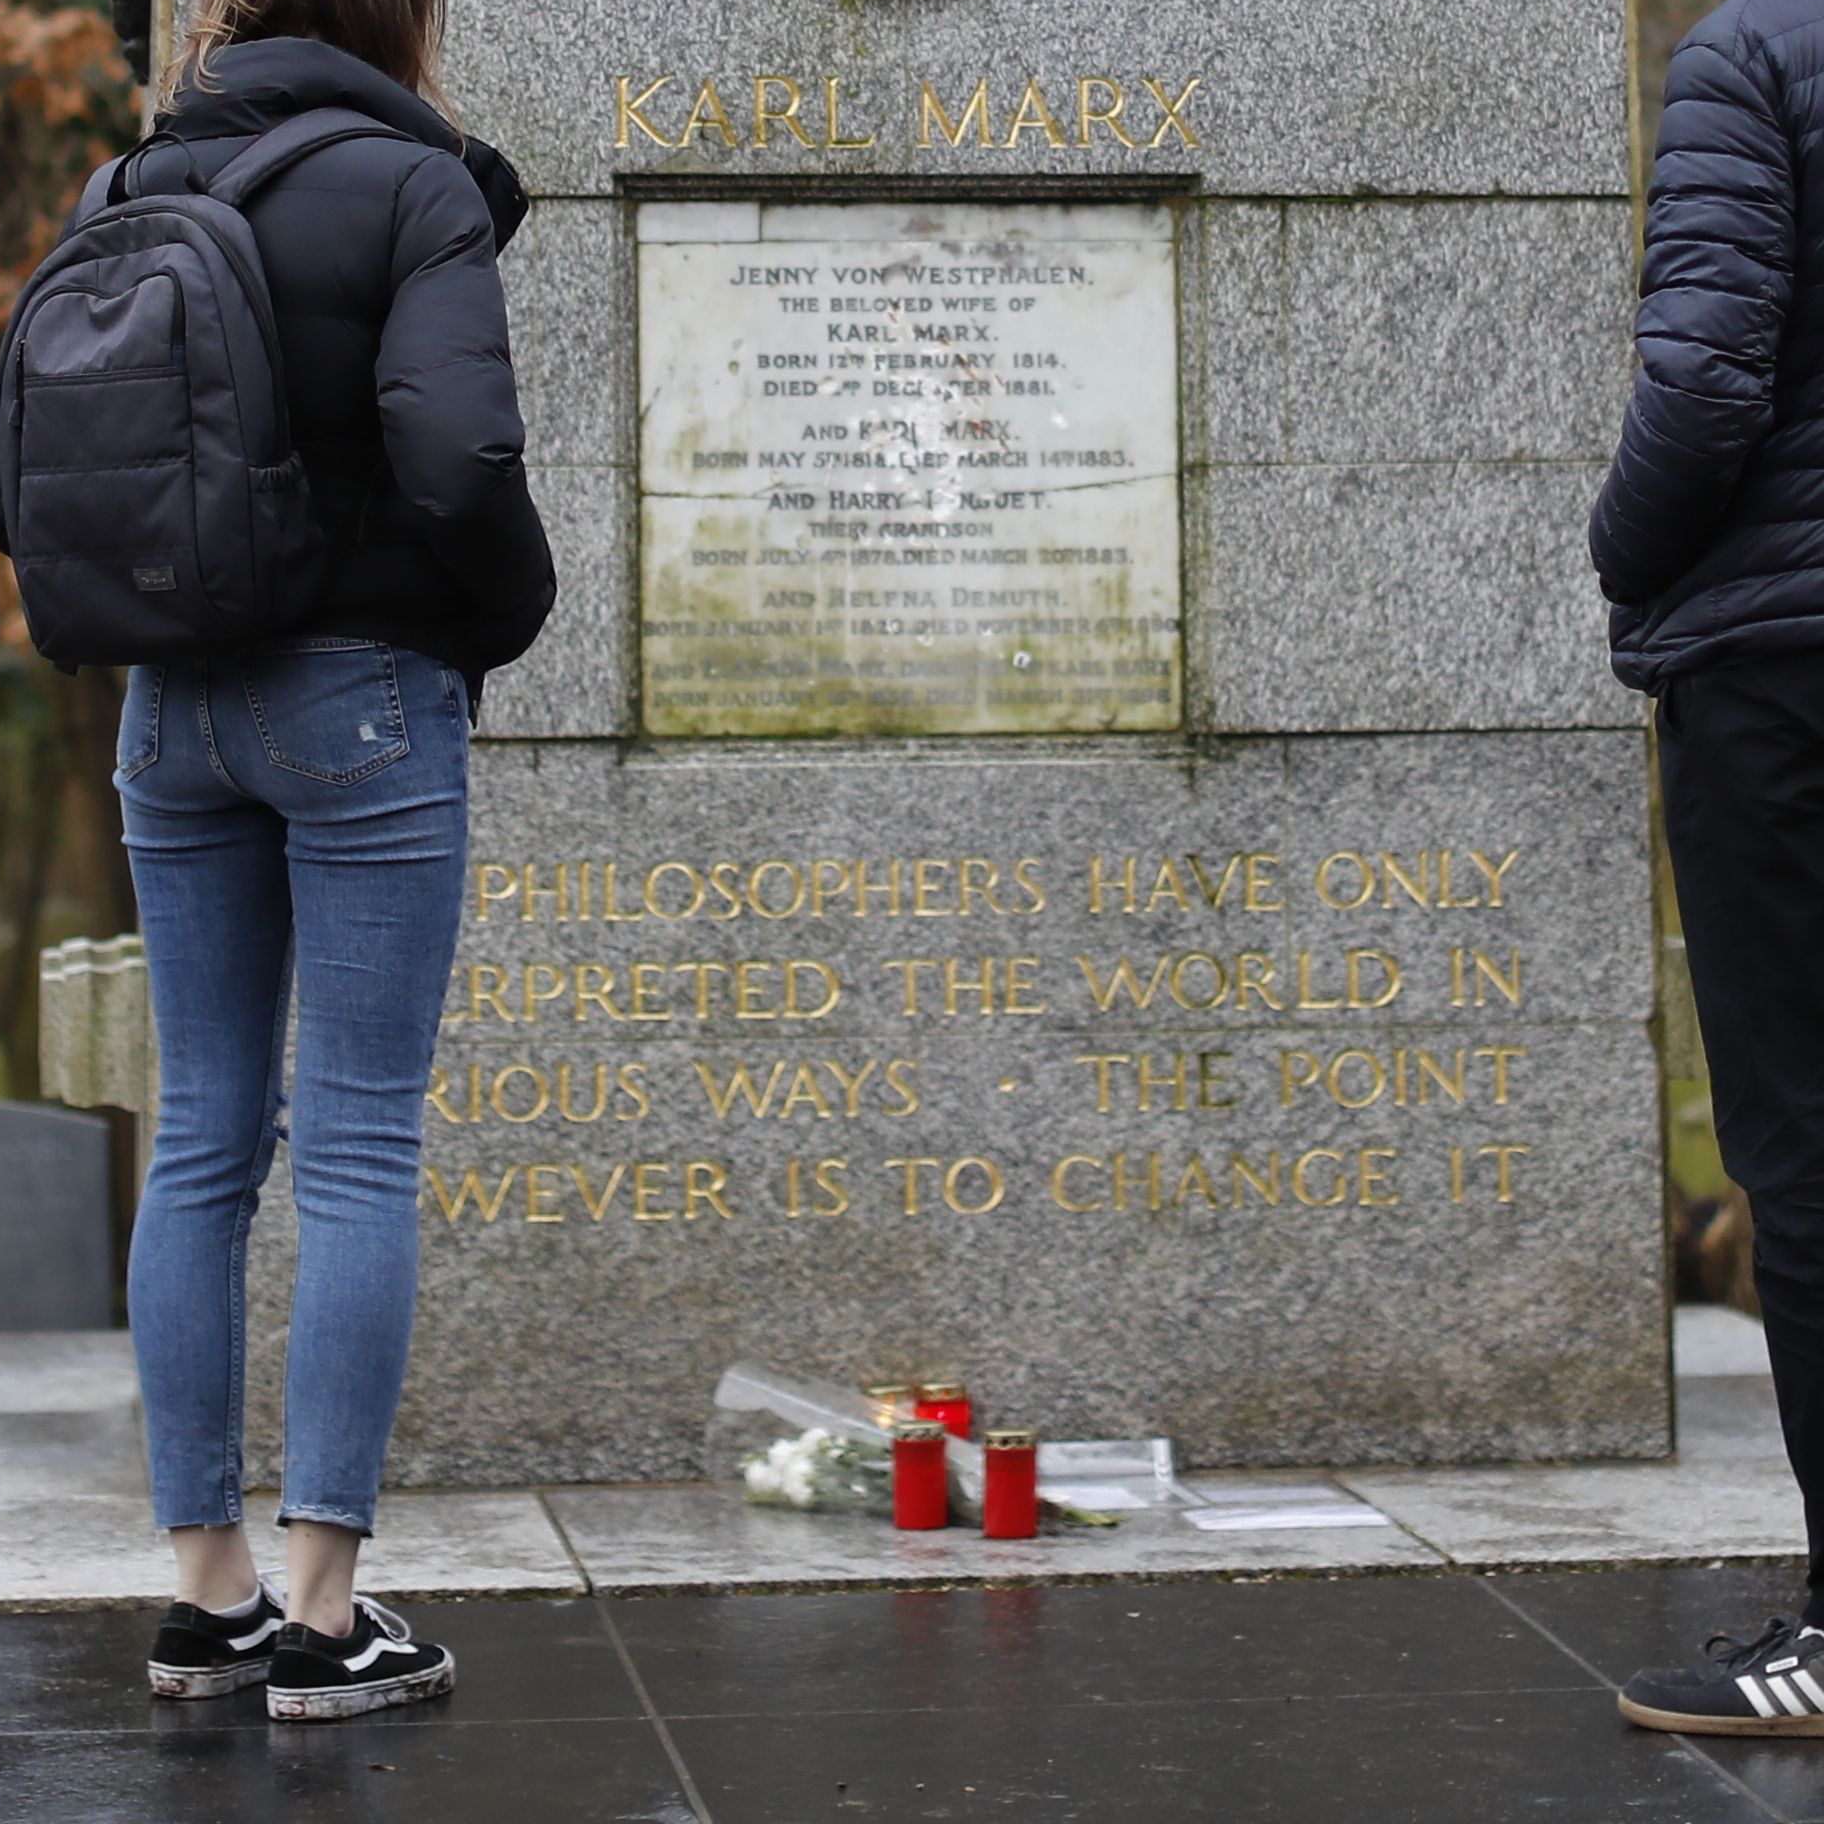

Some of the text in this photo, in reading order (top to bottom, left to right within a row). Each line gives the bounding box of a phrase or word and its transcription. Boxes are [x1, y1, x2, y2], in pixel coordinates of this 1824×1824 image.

[614, 74, 1202, 150] KARL MARX
[729, 265, 819, 286] JENNY
[831, 267, 887, 286] VON
[778, 297, 1036, 313] THE BELOVED WIFE OF
[827, 324, 999, 343] KARL MARX.
[757, 353, 817, 369] BORN
[874, 353, 996, 370] FEBRUARY
[1011, 353, 1067, 369] 1814.
[763, 380, 817, 396] DIED
[872, 379, 991, 397] DECER
[801, 424, 848, 442] AND
[692, 452, 749, 468] BORN
[758, 452, 806, 468] MAY
[957, 451, 1028, 468] MARCH
[1077, 451, 1135, 468] 1883.
[767, 491, 815, 511] AND
[829, 490, 906, 511] HARRY
[878, 522, 993, 538] GRANDSON
[691, 550, 748, 566] BORN
[755, 550, 808, 567] JULY
[902, 550, 955, 566] DIED
[960, 550, 1028, 566] MARCH
[762, 590, 817, 609] AND
[475, 848, 1520, 923] PHILOSOPHERS HAVE ONLY
[885, 955, 1046, 1017] THE
[1078, 949, 1402, 1013] WORLD
[1449, 948, 1526, 1008] IN
[693, 1059, 922, 1119] WAYS
[1076, 1052, 1236, 1112] THE
[1278, 1045, 1528, 1109] POINT
[416, 1144, 1531, 1223] WEVER IS TO CHANGE IT
